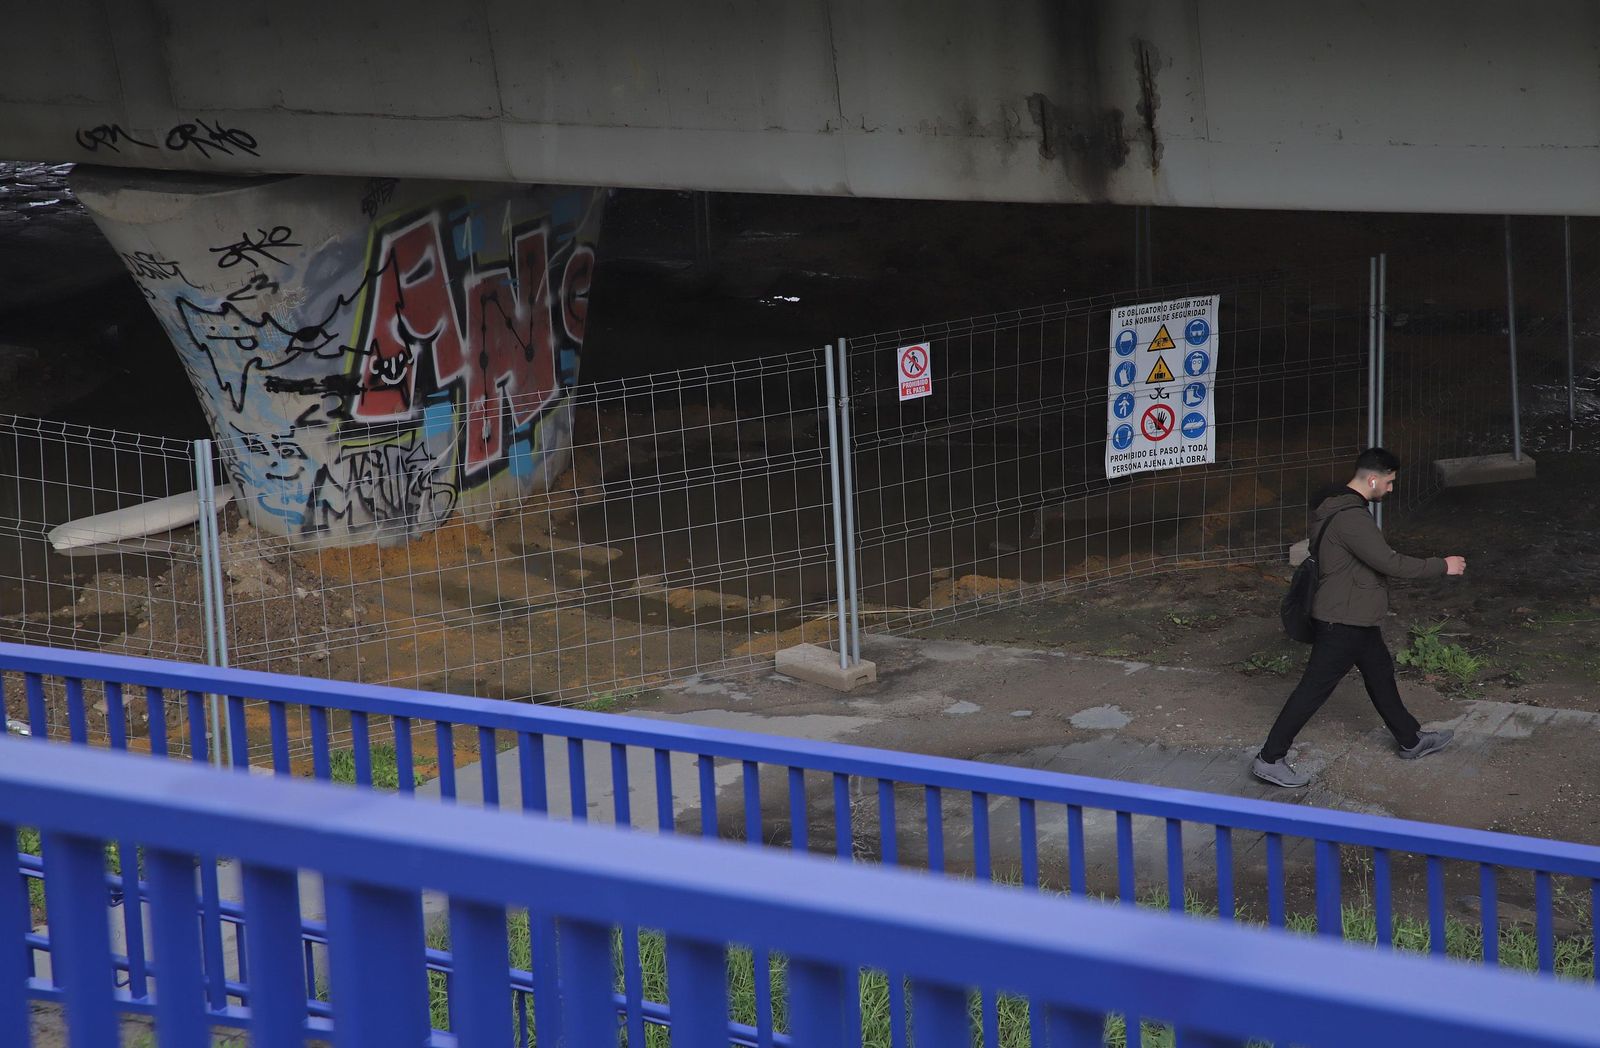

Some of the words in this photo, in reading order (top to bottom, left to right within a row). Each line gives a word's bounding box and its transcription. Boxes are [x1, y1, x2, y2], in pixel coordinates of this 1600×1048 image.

[1118, 310, 1125, 318] ES
[1127, 304, 1168, 316] OBLIGATORIO
[1169, 300, 1191, 311] SEGUIR
[1193, 299, 1212, 308] TODAS
[1122, 319, 1133, 327] LAS
[1135, 315, 1161, 325] NORMAS
[1171, 308, 1206, 320] SEGURIDAD
[902, 378, 928, 389] PROHIBIDO
[913, 386, 925, 394] PASO
[1110, 450, 1147, 463] PROHIBIDO
[1149, 449, 1157, 457] EL
[1160, 446, 1179, 455] PASO
[1188, 444, 1208, 452] TODA
[1113, 463, 1141, 473] PERSONA
[1143, 458, 1166, 468] AJENA
[1186, 455, 1206, 463] OBRA
